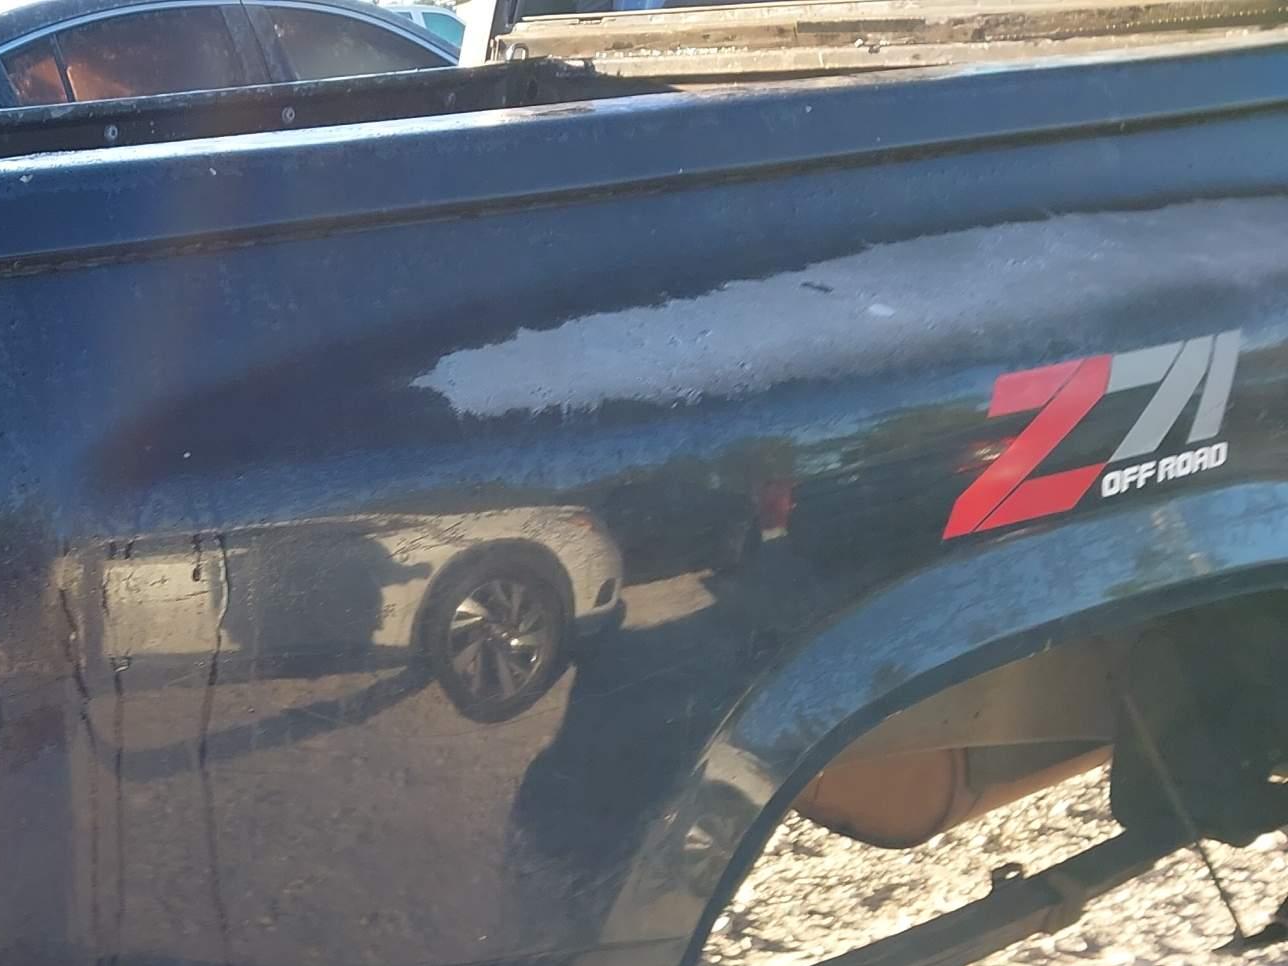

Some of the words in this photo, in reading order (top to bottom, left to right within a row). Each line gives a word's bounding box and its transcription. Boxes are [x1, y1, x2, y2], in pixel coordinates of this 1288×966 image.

[943, 328, 1242, 540] Z71
[1101, 460, 1158, 498] OFF
[1157, 442, 1229, 483] ROAD
